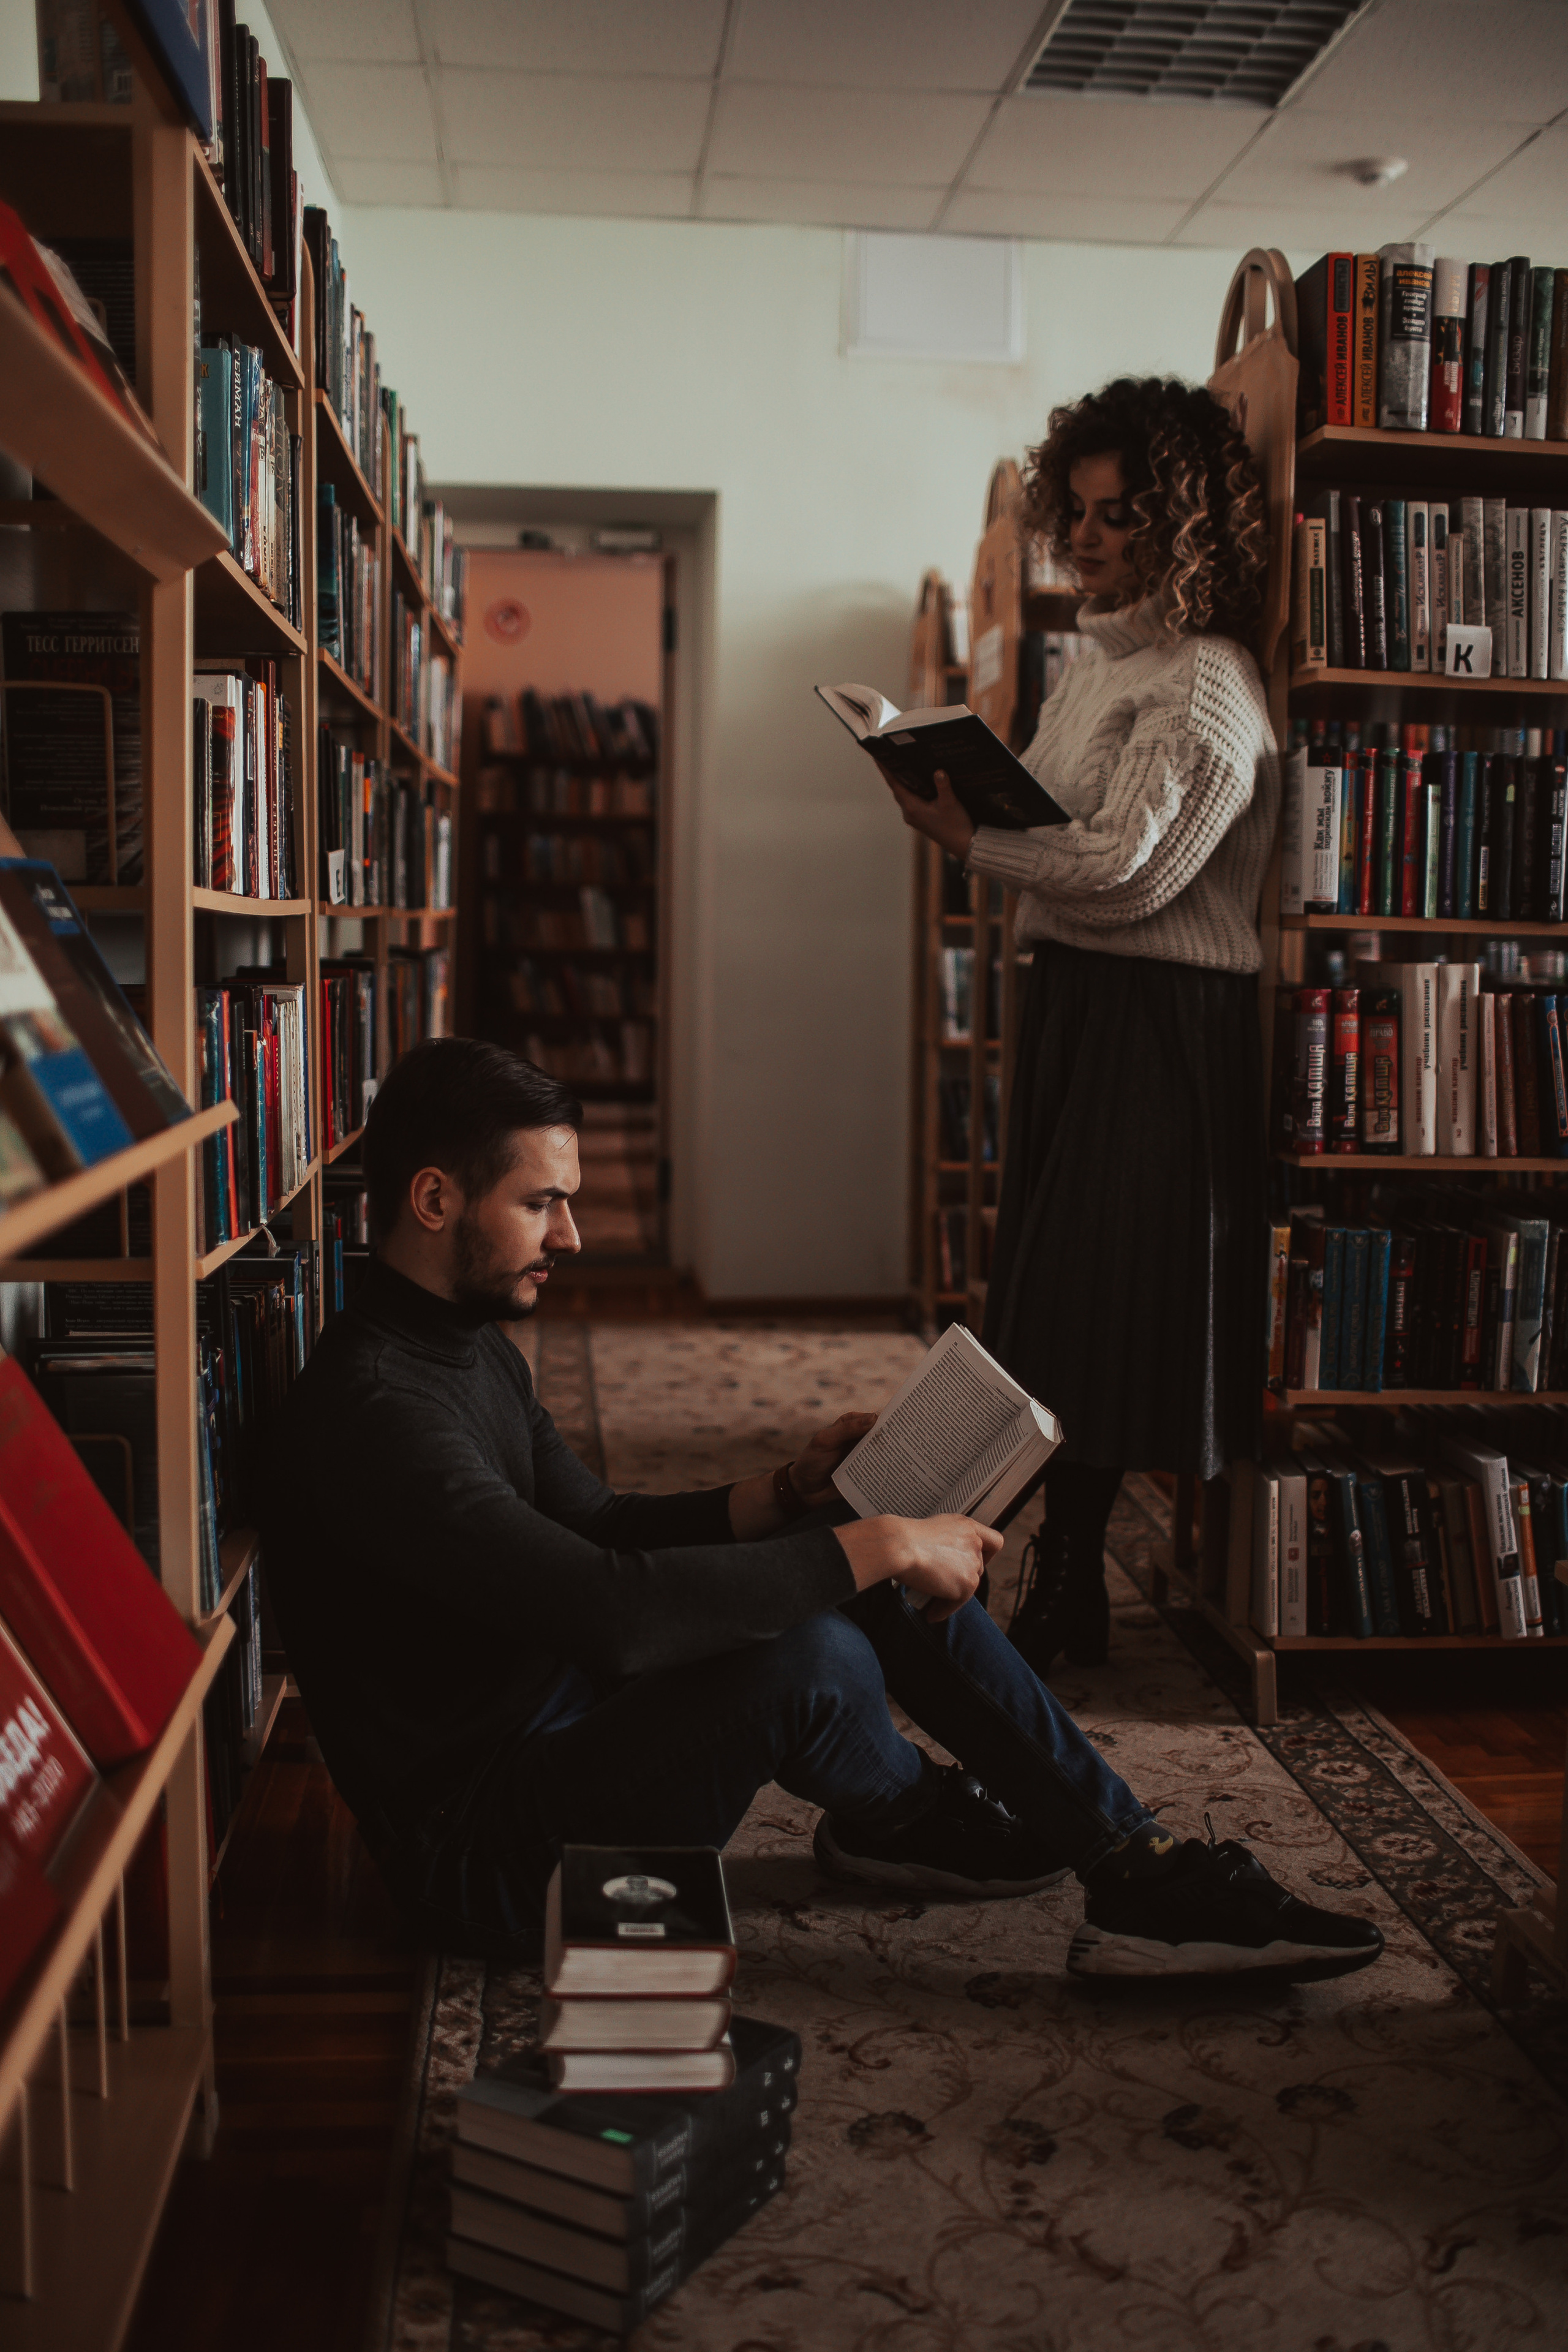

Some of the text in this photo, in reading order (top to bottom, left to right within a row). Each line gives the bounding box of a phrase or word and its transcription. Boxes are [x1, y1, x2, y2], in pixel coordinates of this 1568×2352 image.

[1362, 317, 1374, 361] ИВАНОВ
[1334, 315, 1348, 405] АЛЕКСЕЙ ИВАНОВ
[1360, 363, 1373, 405] АЛЕКСЕЙ
[1510, 550, 1524, 618] АКСЕНОВ
[26, 635, 140, 654] ТЕСС ГЕРРИТСЕН
[1453, 643, 1473, 673] К
[1321, 769, 1335, 804] войну
[1316, 807, 1325, 827] мы
[1323, 805, 1332, 850] пережили
[1313, 828, 1325, 850] Как
